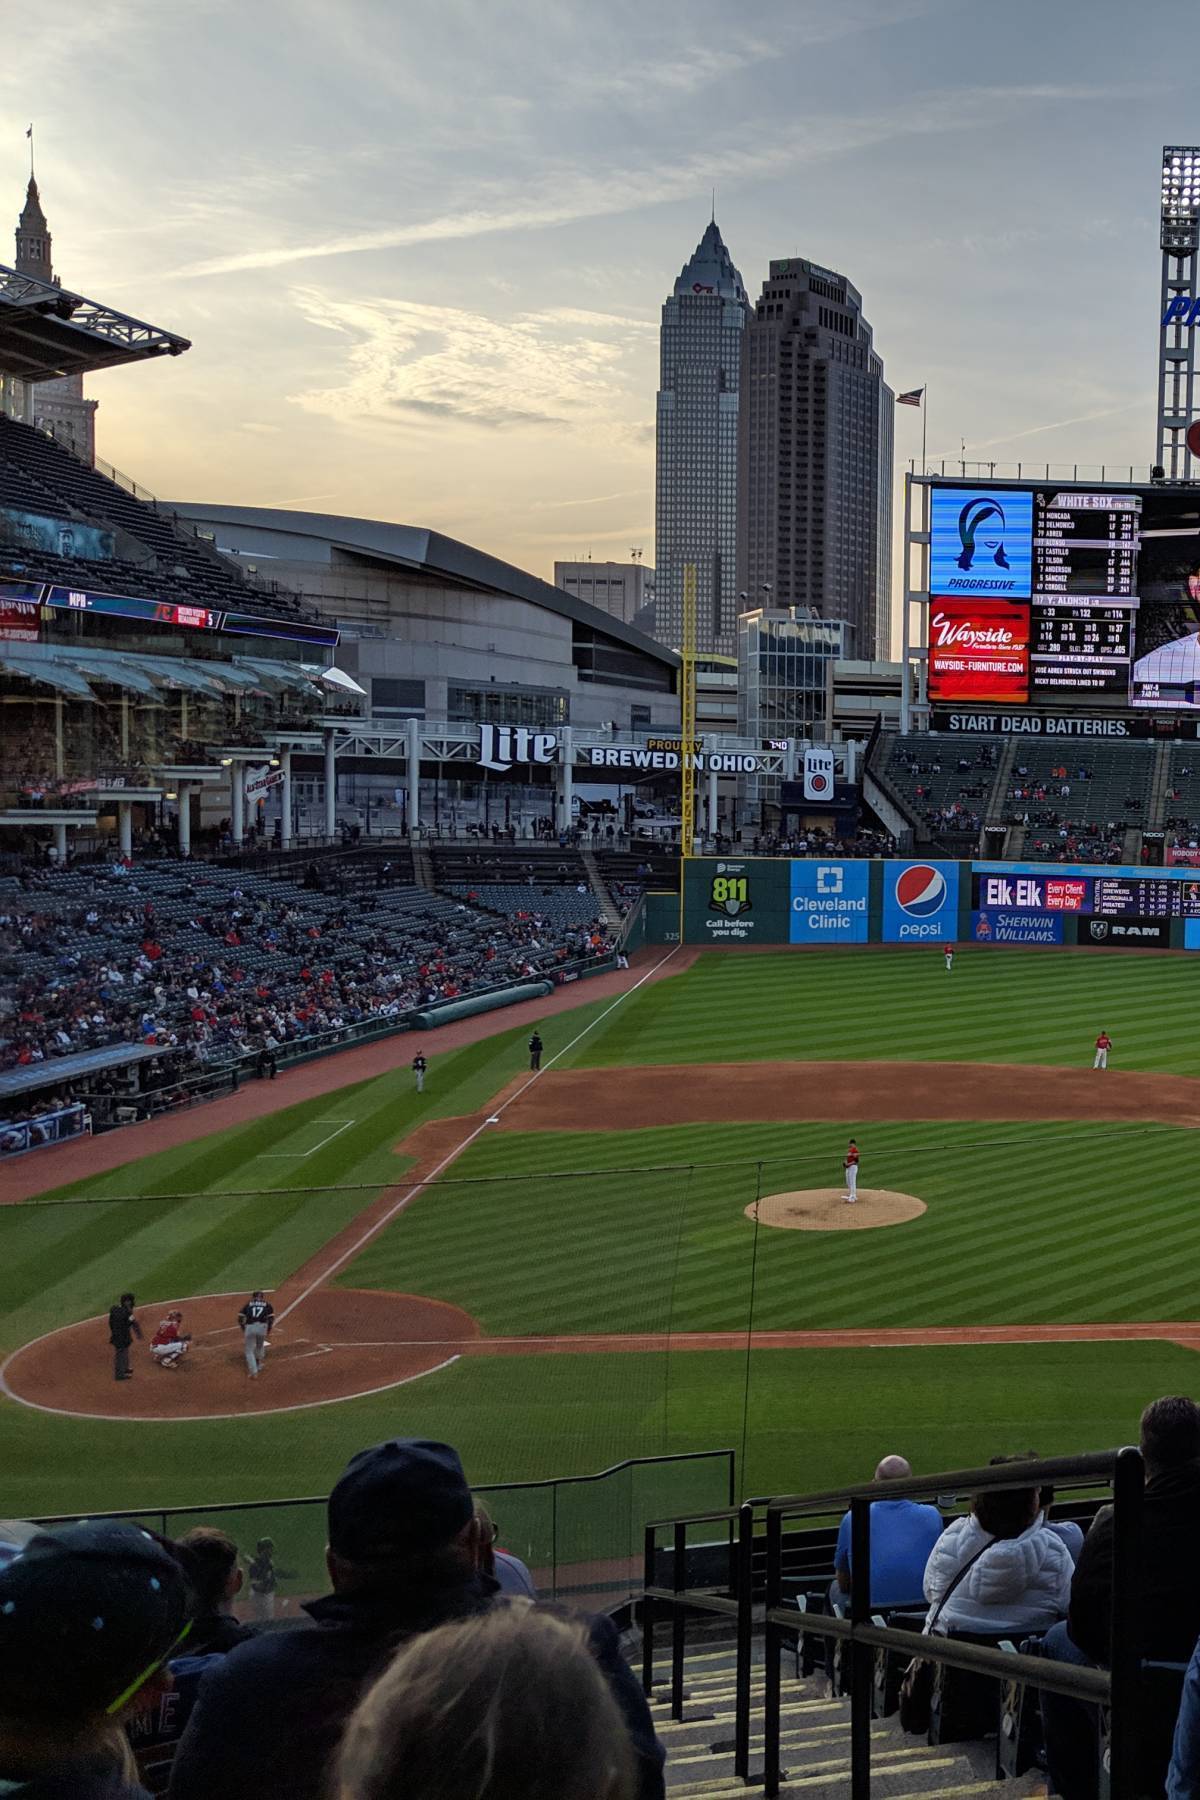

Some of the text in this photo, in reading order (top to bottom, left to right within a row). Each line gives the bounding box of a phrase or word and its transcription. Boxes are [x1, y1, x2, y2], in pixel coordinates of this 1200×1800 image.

[1058, 496, 1089, 507] WHITE
[1092, 497, 1112, 508] SOX
[948, 578, 1016, 590] PROGRESSIVE
[1058, 597, 1089, 606] ALONSO
[1048, 608, 1091, 617] 33 132
[933, 613, 1013, 649] Wayside
[1116, 624, 1123, 632] 37
[1045, 632, 1052, 640] 16
[935, 660, 1023, 672] WAYSIDE-FURNITURE.COM
[950, 715, 1130, 736] START DEAD BATTERIES.
[476, 723, 557, 771] Lite
[648, 739, 702, 751] PROUY
[591, 749, 678, 769] BREWED
[710, 755, 757, 771] OHIO
[807, 758, 832, 773] Lite
[713, 878, 747, 902] 811
[987, 879, 1041, 906] Elk Elk
[1047, 883, 1064, 896] Every
[792, 897, 866, 912] Cleveland
[1047, 895, 1064, 908] Every
[808, 915, 850, 929] Clinic
[996, 914, 1054, 928] SHERWIN
[664, 932, 680, 940] 325
[712, 928, 748, 937] you dig.
[900, 922, 941, 937] pepsi
[1112, 926, 1160, 936] RAM
[252, 1307, 264, 1317] 17
